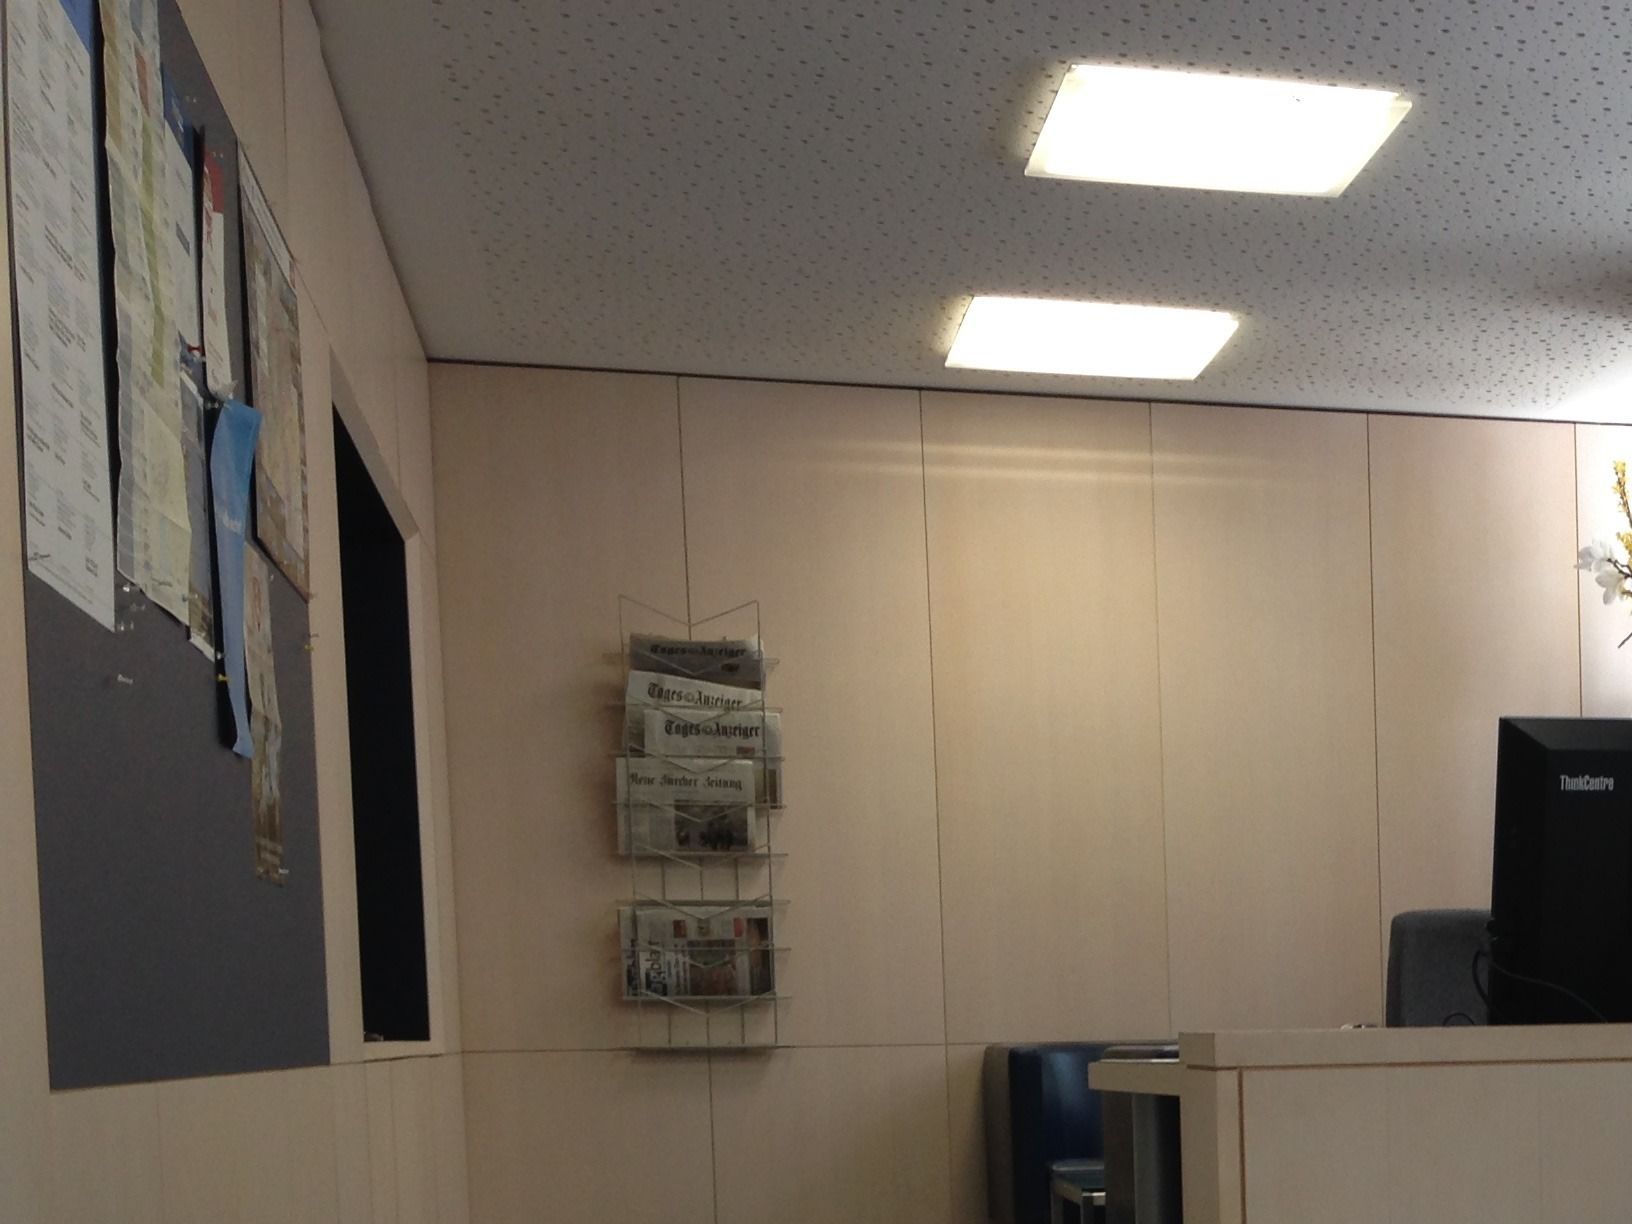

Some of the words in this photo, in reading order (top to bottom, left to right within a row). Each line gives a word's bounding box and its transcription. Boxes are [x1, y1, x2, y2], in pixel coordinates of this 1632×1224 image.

[647, 682, 683, 705] Tages
[664, 719, 701, 738] Tages
[711, 722, 761, 740] Anzeiger
[1559, 773, 1615, 792] ThinkCentre
